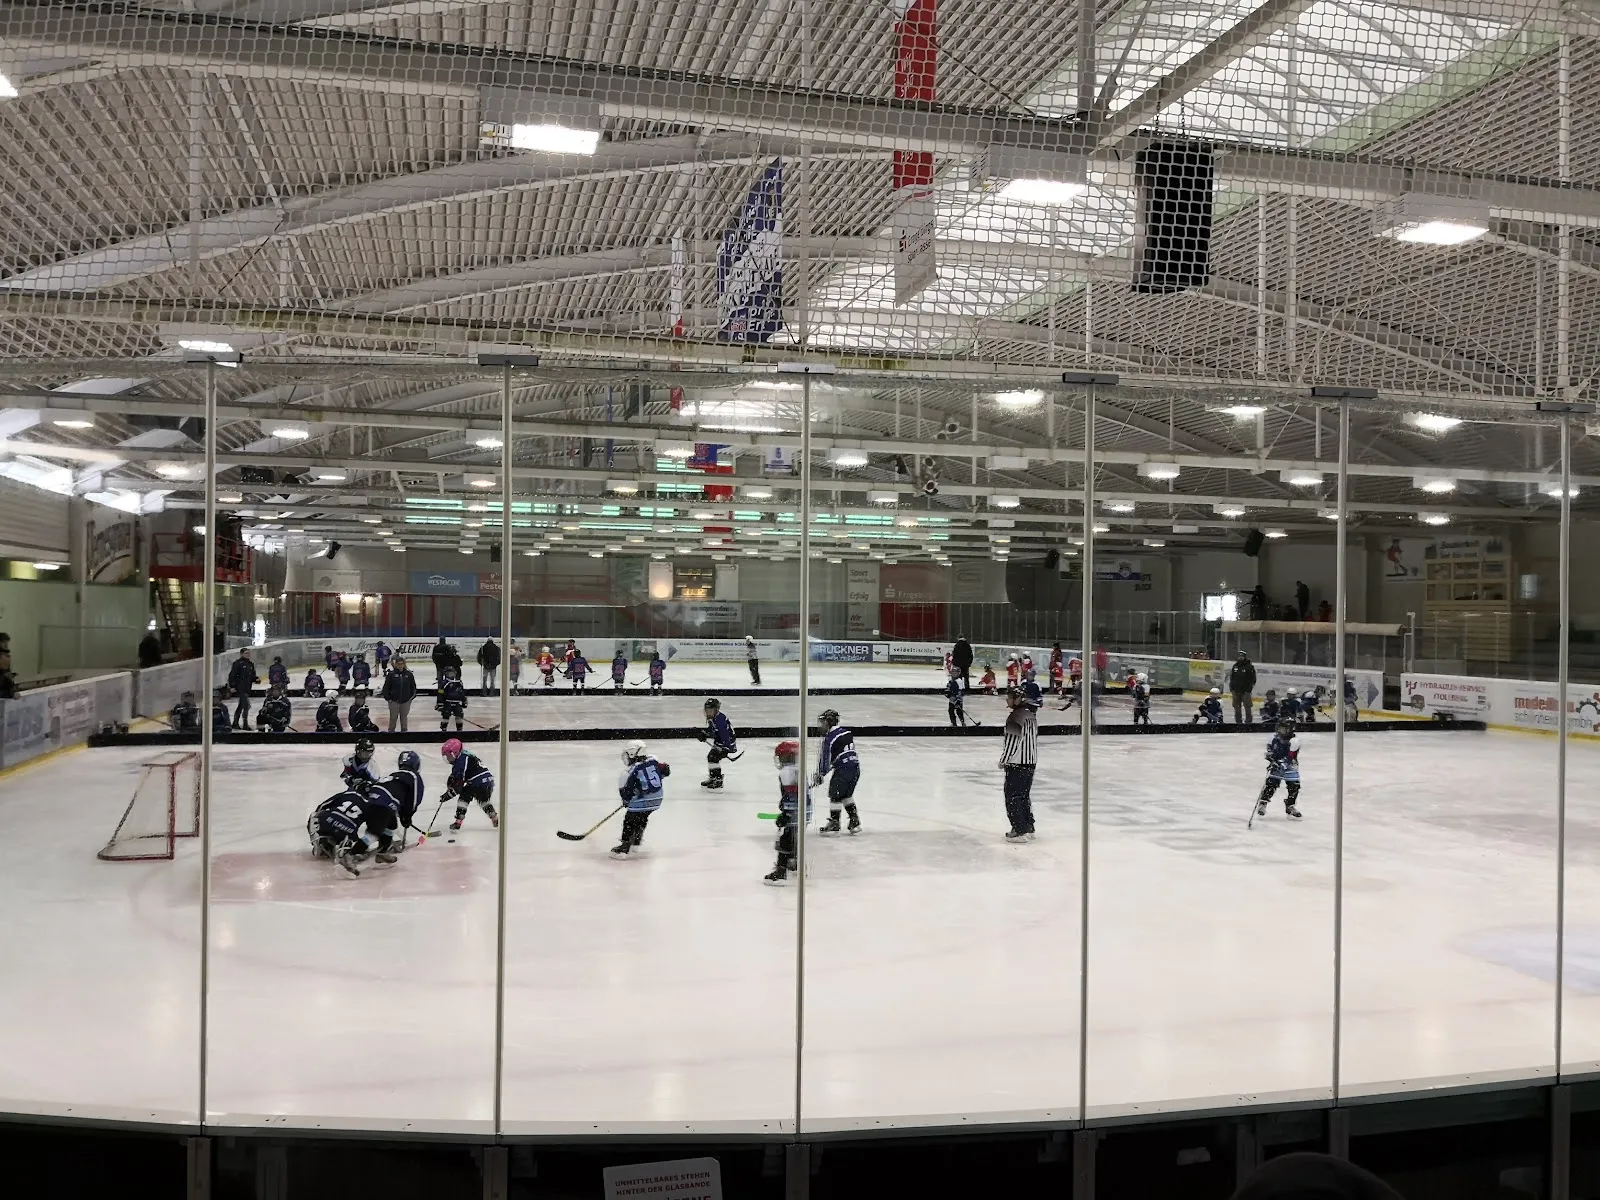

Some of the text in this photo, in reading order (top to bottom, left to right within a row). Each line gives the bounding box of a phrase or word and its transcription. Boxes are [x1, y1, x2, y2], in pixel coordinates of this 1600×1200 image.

[615, 1172, 710, 1187] UNMITTELBARES STEHEN
[616, 1181, 711, 1196] HINTER DER GLASBANDE
